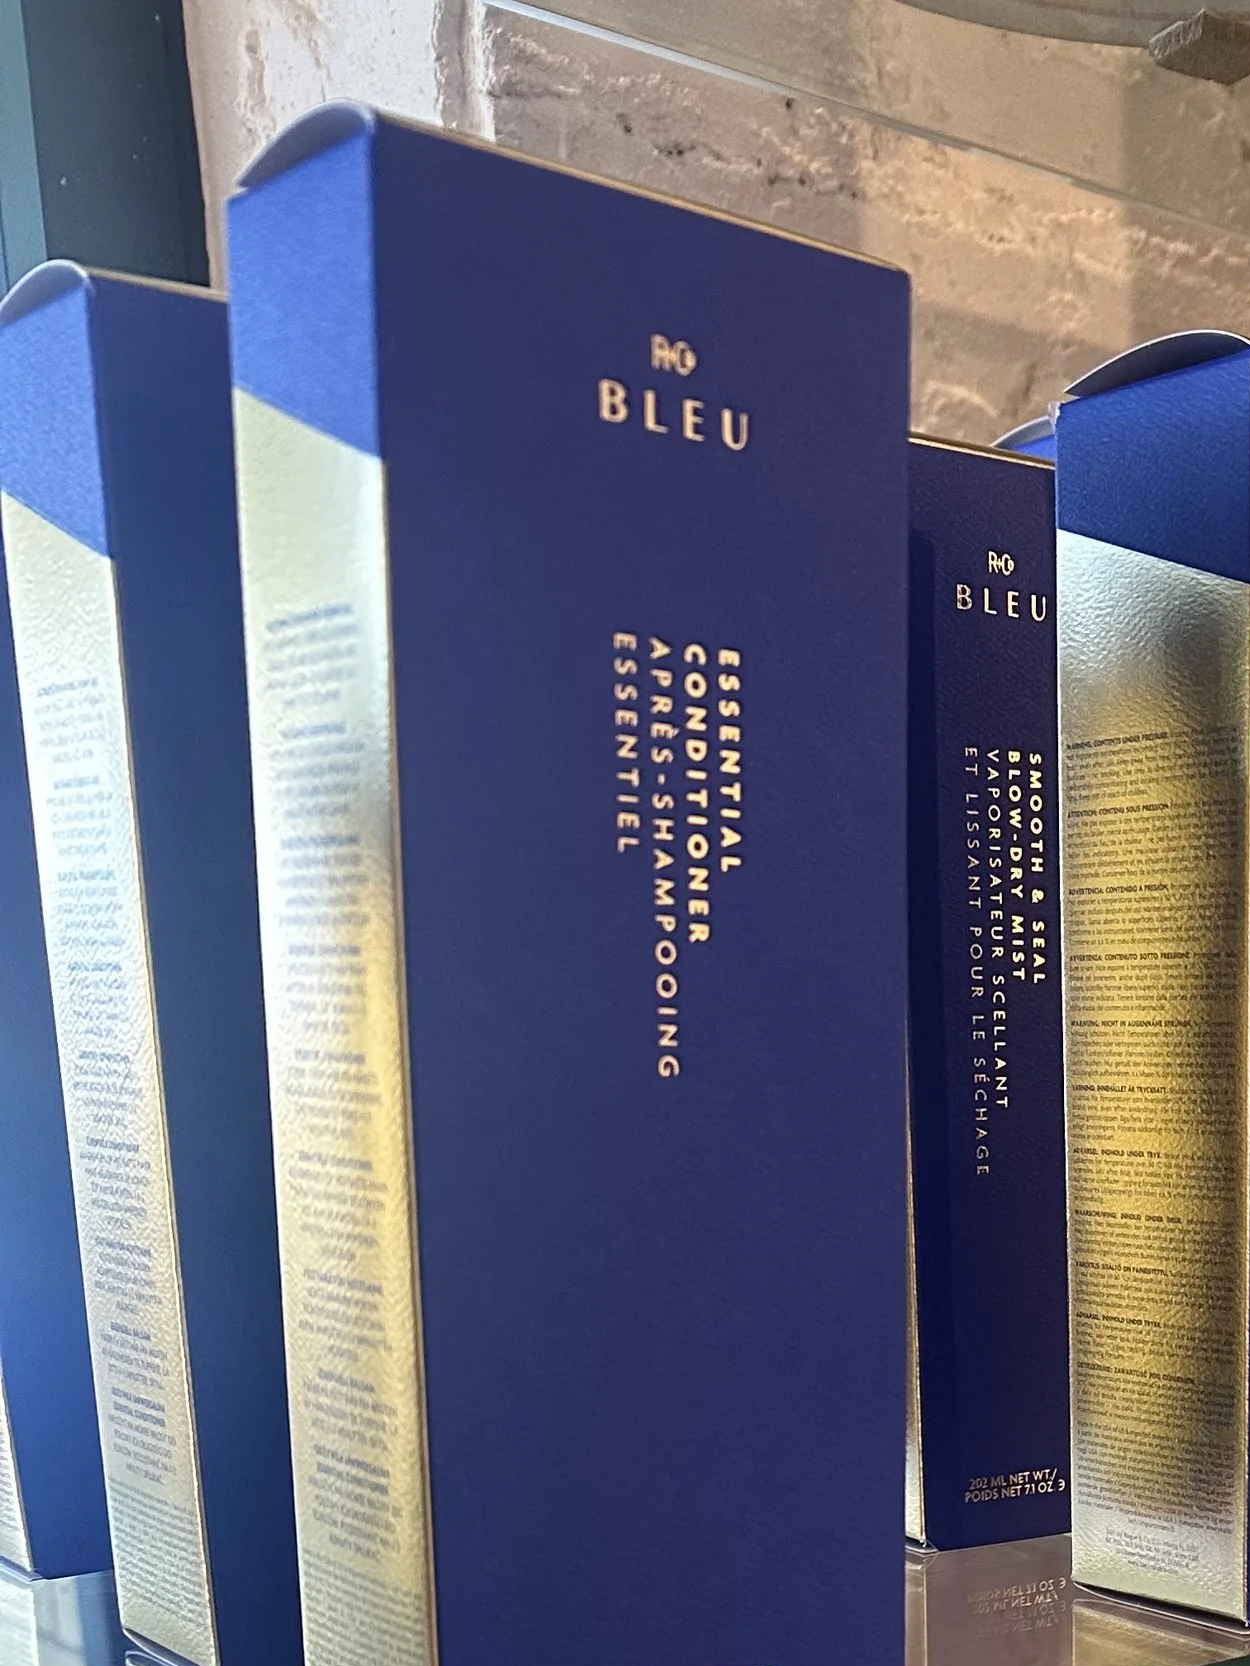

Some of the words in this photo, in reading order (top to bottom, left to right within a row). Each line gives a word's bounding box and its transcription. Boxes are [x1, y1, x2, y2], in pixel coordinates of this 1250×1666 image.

[598, 378, 749, 451] BLEU
[956, 584, 1047, 621] BLEU
[613, 631, 640, 855] ESSENTIEL
[718, 648, 742, 874] ESSENTIAL
[964, 746, 979, 775] ET
[684, 642, 710, 945] CONDITIONER
[1007, 750, 1024, 898] BLOW-DRY
[1028, 753, 1044, 872] SMOOTH
[649, 638, 685, 1079] APRÈS-SHAMPOOING
[965, 793, 982, 908] LISSANT
[985, 748, 1005, 958] VAPORISATEUR
[1030, 888, 1045, 904] &
[969, 926, 984, 998] POUR
[1010, 915, 1026, 980] MIST
[1031, 920, 1046, 984] SEAL
[971, 1014, 986, 1041] LE
[991, 974, 1008, 1107] SCELLANT
[972, 1057, 989, 1175] SÉCHAGE
[964, 1487, 999, 1503] POIDS
[1001, 1485, 1023, 1498] NET
[968, 1476, 988, 1490] 202
[990, 1474, 1007, 1488] ML
[1009, 1471, 1031, 1484] NET
